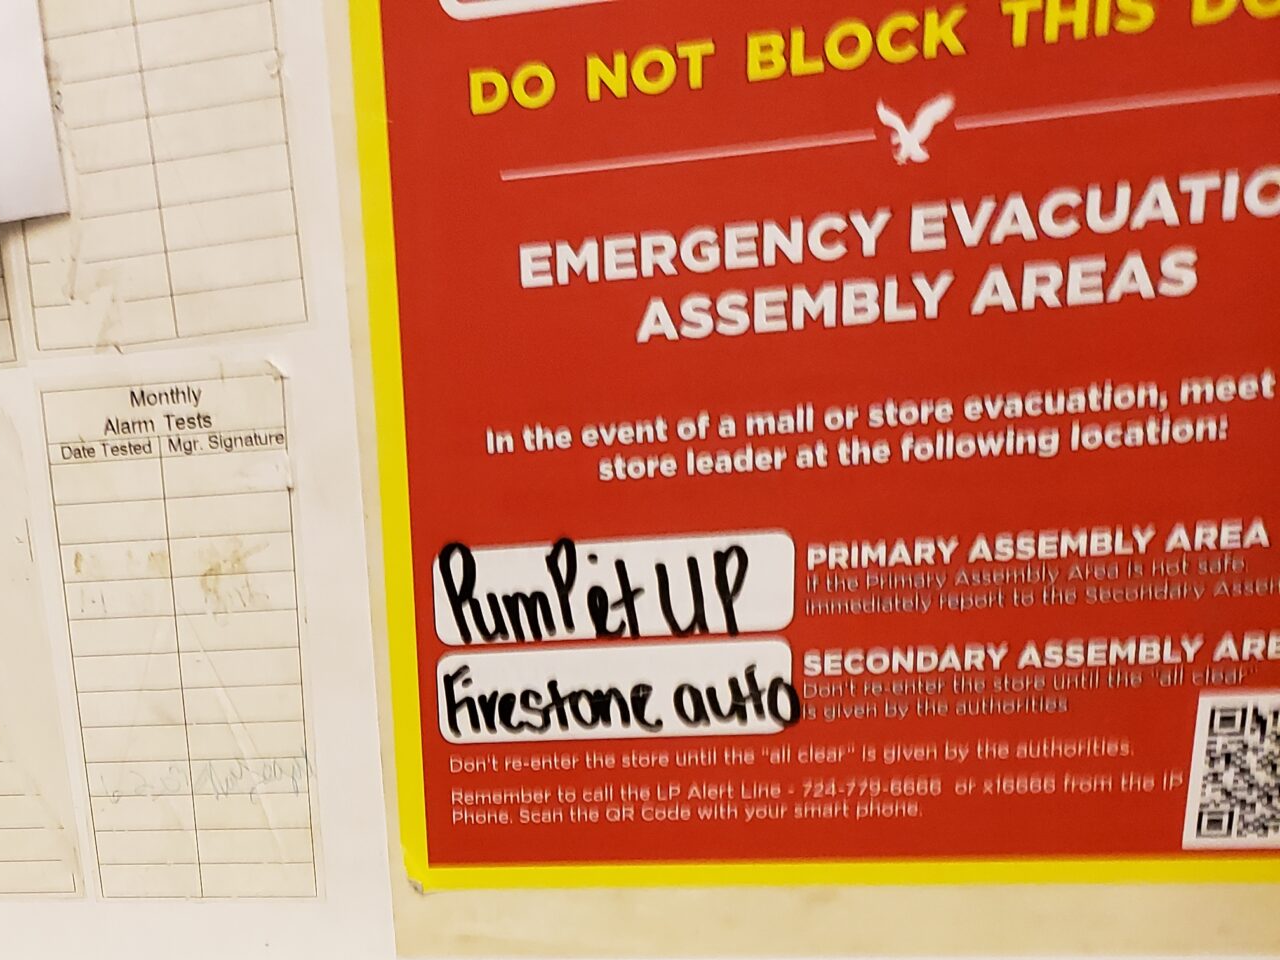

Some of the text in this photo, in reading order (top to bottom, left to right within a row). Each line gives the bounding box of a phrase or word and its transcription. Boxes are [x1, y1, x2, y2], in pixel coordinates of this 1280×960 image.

[469, 62, 556, 115] DO
[586, 38, 715, 101] NOT
[746, 3, 967, 82] BLOCK
[1001, 0, 1155, 48] THIS
[520, 163, 1280, 289] EMERGENCY EVACUATIO
[636, 245, 1198, 343] ASSEMBLY AREAS
[129, 386, 202, 408] Monthly
[486, 367, 1276, 454] In the event of a mall or store evacuation, meet
[104, 413, 213, 436] Alarm Tests
[61, 440, 153, 460] Date Tested
[168, 432, 284, 455] Mgr. Signature
[598, 452, 677, 481] store
[687, 441, 787, 476] leader
[795, 439, 828, 469] at
[837, 434, 891, 466] the
[901, 423, 1059, 458] following
[807, 516, 1270, 571] PRIMARY ASSEMBLY AREA
[826, 569, 858, 593] the
[866, 566, 947, 590] Primary
[955, 560, 1059, 587] Assembly
[1068, 560, 1119, 581] Area
[1152, 553, 1188, 577] not
[939, 588, 1004, 612] report
[1013, 587, 1034, 607] to
[1042, 584, 1077, 606] the
[1086, 579, 1205, 605] Secondary
[803, 640, 1008, 677] SECONDARY
[1017, 632, 1204, 669] ASSEMBLY
[803, 678, 856, 699] Don't
[863, 677, 945, 697] re-enter
[953, 673, 985, 694] the
[993, 672, 1045, 693] store
[1053, 666, 1099, 690] until
[1108, 665, 1142, 688] the
[444, 664, 800, 738] Firestone auto
[823, 701, 877, 722] given
[885, 699, 909, 720] by
[917, 698, 948, 717] the
[450, 753, 498, 773] Don't
[504, 752, 580, 772] re-enter
[585, 750, 616, 769] the
[621, 749, 669, 768] store
[675, 746, 717, 767] until
[724, 744, 755, 765] the
[761, 743, 791, 764] "all
[797, 742, 855, 764] clear"
[861, 744, 876, 763] is
[883, 742, 938, 765] given
[944, 739, 969, 763] by
[976, 737, 1009, 760] the
[451, 784, 551, 806] Remember
[557, 784, 576, 803] to
[582, 783, 614, 803] call
[620, 782, 650, 802] the
[656, 782, 681, 801] LP
[687, 779, 734, 800] Alert
[741, 778, 781, 799] Line
[802, 773, 942, 798] 724-779-6666
[954, 776, 975, 796] or
[1063, 770, 1112, 793] from
[1120, 770, 1155, 793] the
[452, 798, 923, 825] Phone. Scan the QR Code with your smart phone.
